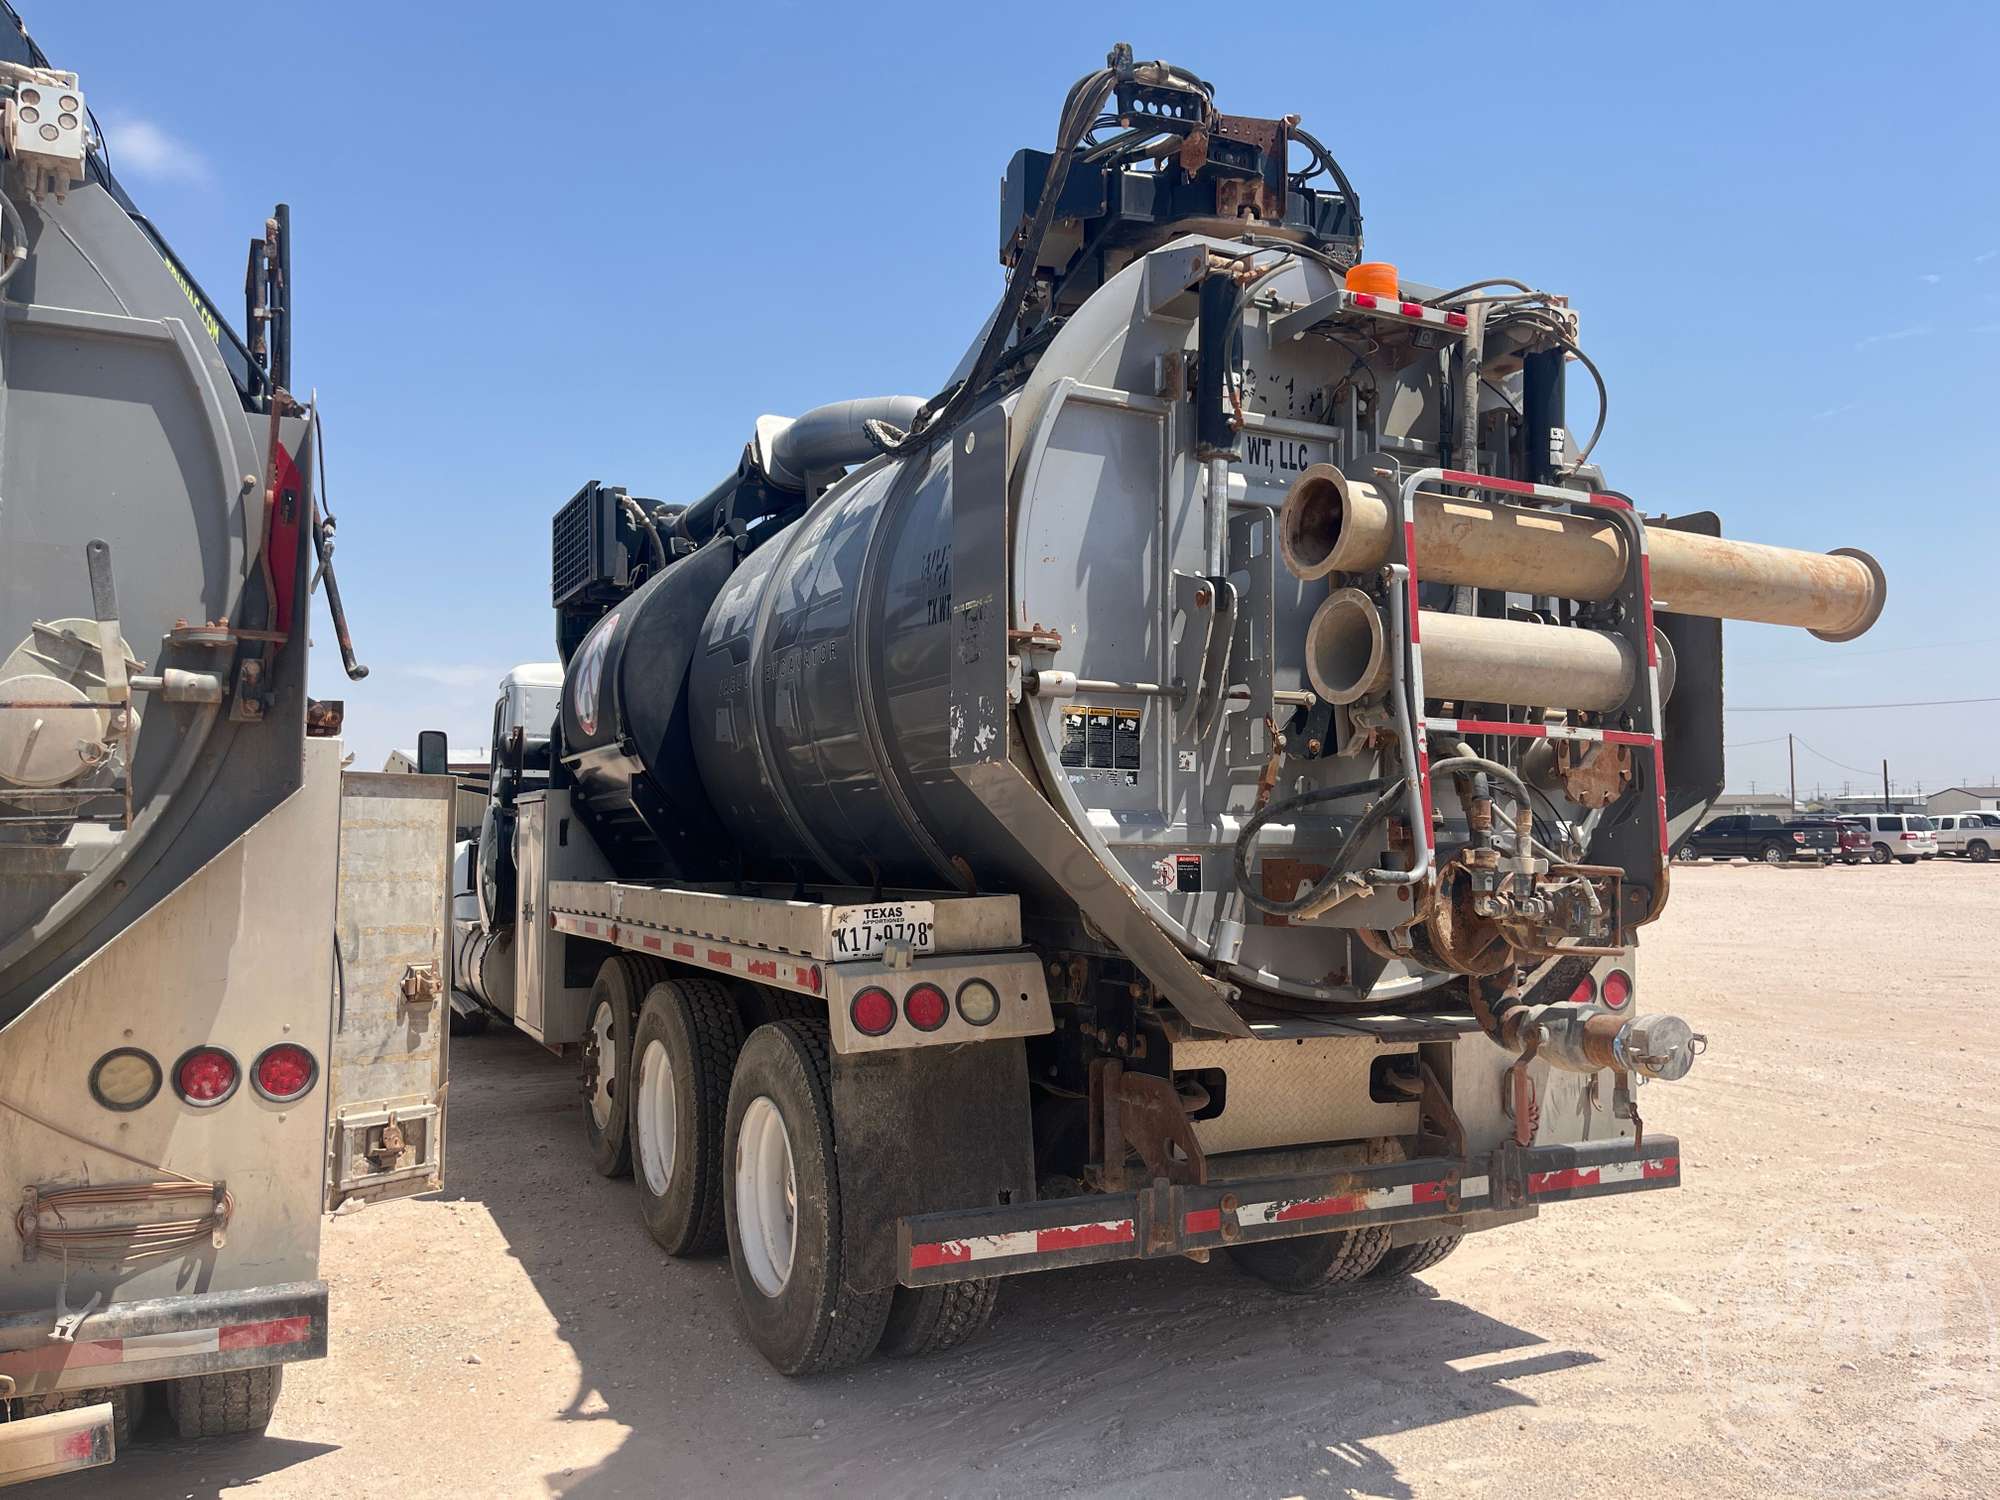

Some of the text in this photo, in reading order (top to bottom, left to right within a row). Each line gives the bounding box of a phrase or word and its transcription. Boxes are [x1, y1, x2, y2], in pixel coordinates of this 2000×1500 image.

[1247, 436, 1308, 474] WT, LLC
[928, 597, 938, 625] TX
[862, 917, 905, 925] APPORTIONED
[864, 907, 903, 918] TEXAS
